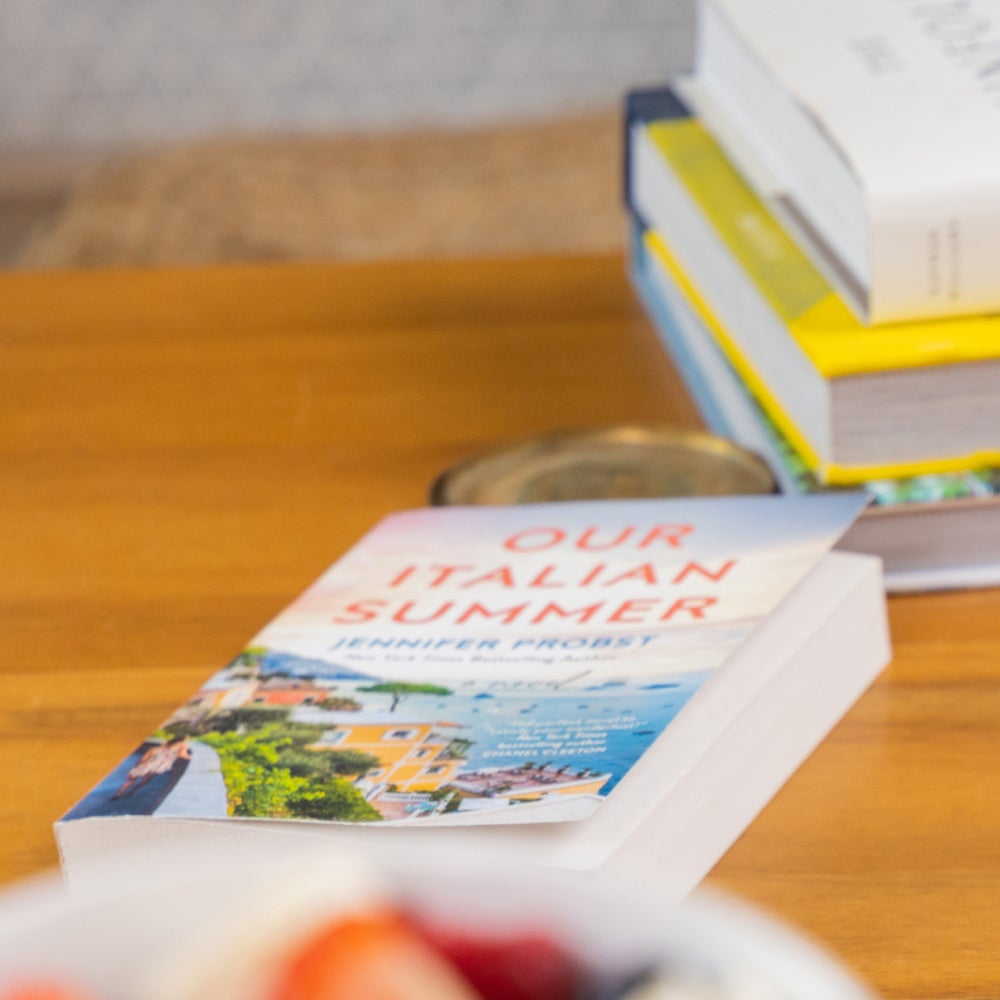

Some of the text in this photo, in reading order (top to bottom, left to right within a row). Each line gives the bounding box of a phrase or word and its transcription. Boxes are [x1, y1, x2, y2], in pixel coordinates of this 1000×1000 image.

[503, 524, 697, 553] OUR
[388, 559, 738, 588] ITALIAN
[332, 596, 721, 625] SUMMER
[329, 635, 661, 651] JENNIFER PROBST
